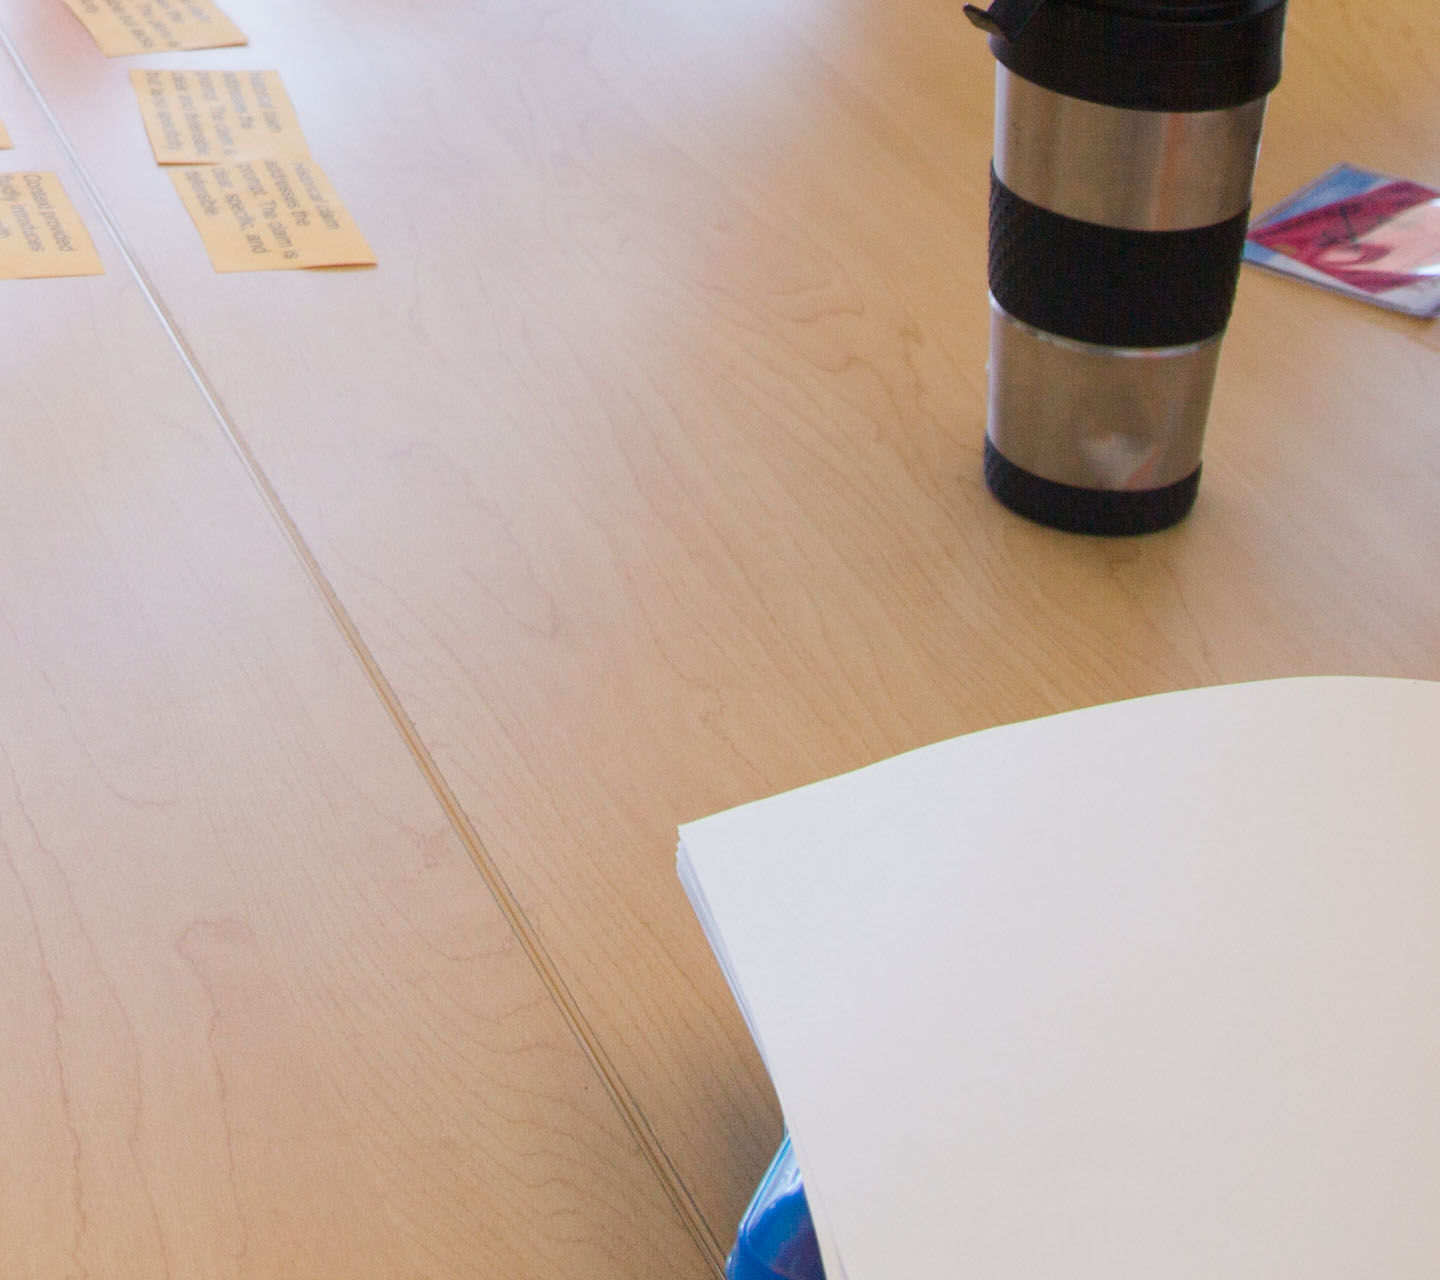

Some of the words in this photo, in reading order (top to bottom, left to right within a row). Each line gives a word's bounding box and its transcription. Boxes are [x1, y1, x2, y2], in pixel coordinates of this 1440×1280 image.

[264, 160, 301, 208] addresses
[291, 210, 311, 226] the
[23, 174, 52, 209] Context
[39, 211, 79, 252] provided
[258, 200, 278, 220] The
[315, 204, 341, 230] claim
[10, 205, 46, 252] introduces
[267, 222, 294, 248] claim
[246, 234, 272, 254] and
[282, 250, 302, 260] is
